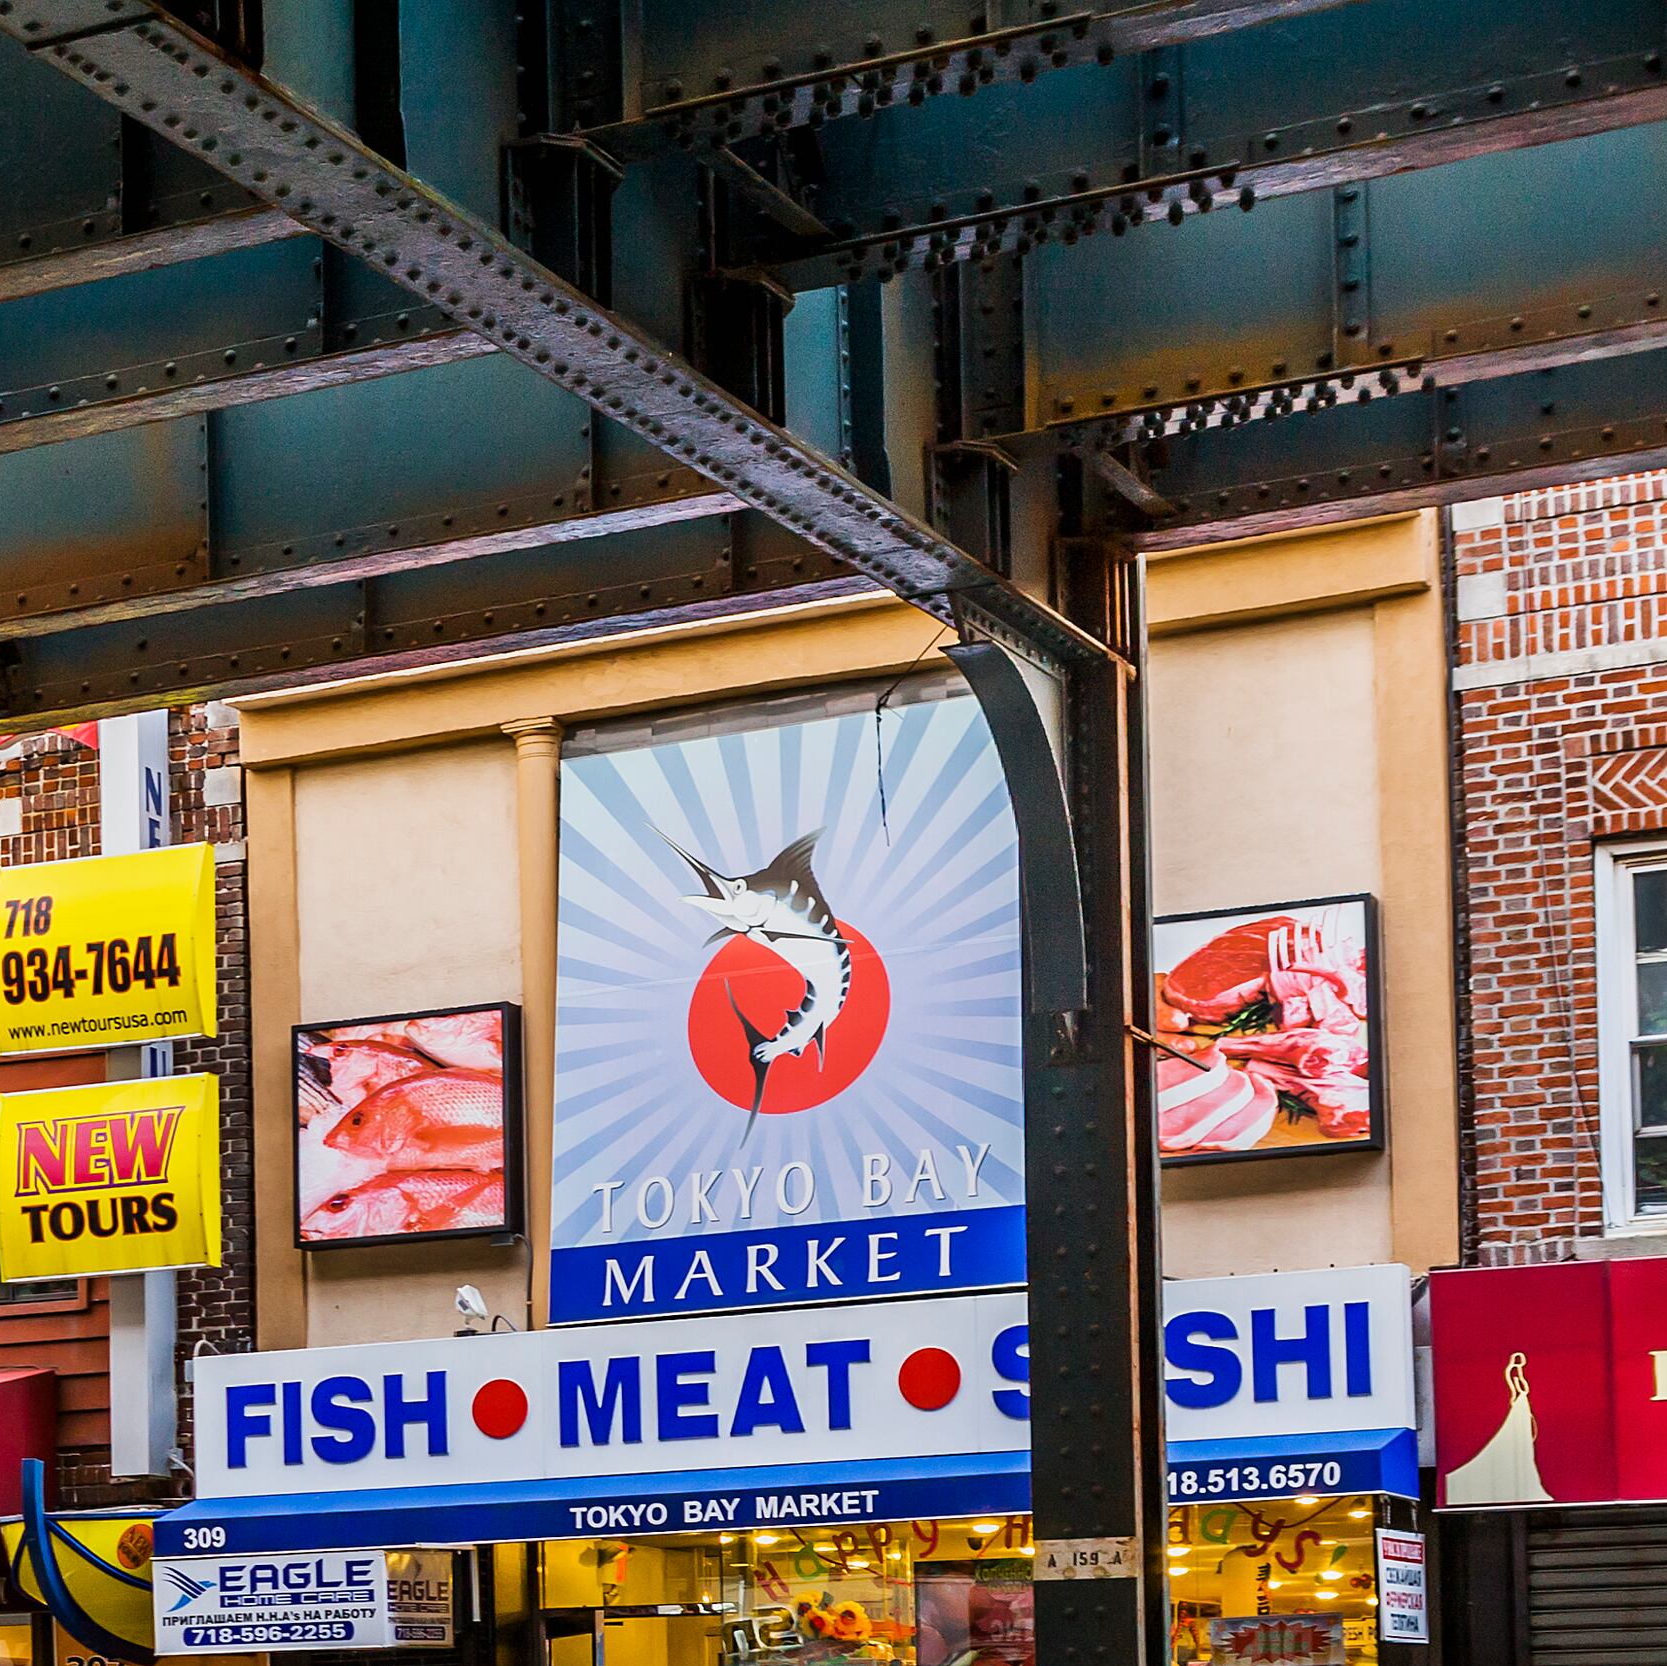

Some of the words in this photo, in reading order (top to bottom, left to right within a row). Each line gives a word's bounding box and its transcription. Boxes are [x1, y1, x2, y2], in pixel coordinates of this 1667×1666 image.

[4, 895, 53, 939] 718
[2, 932, 181, 1006] 934-7644
[8, 1008, 187, 1040] www.newtoursusa.com
[15, 1105, 185, 1197] NEW
[593, 1160, 815, 1233] TOKYO
[863, 1143, 991, 1208] BAY
[21, 1192, 178, 1244] TOURS
[602, 1226, 968, 1307] MARKET
[225, 1369, 449, 1470] FISH
[558, 1338, 871, 1448] MEAT
[184, 1527, 227, 1549] 309
[569, 1502, 667, 1530] TOKYO
[684, 1497, 740, 1523] BAY
[755, 1490, 880, 1519] MARKET
[219, 1558, 375, 1593] EAGLE
[1073, 1551, 1099, 1566] 159
[224, 1592, 292, 1608] HOME
[299, 1590, 370, 1604] CARE
[386, 1580, 450, 1601] EAGLE
[162, 1612, 254, 1627] ПРИГЛАШАЕМ
[303, 1609, 323, 1621] НА
[324, 1607, 378, 1620] РАБОТУ
[191, 1623, 347, 1645] 718-596-2255
